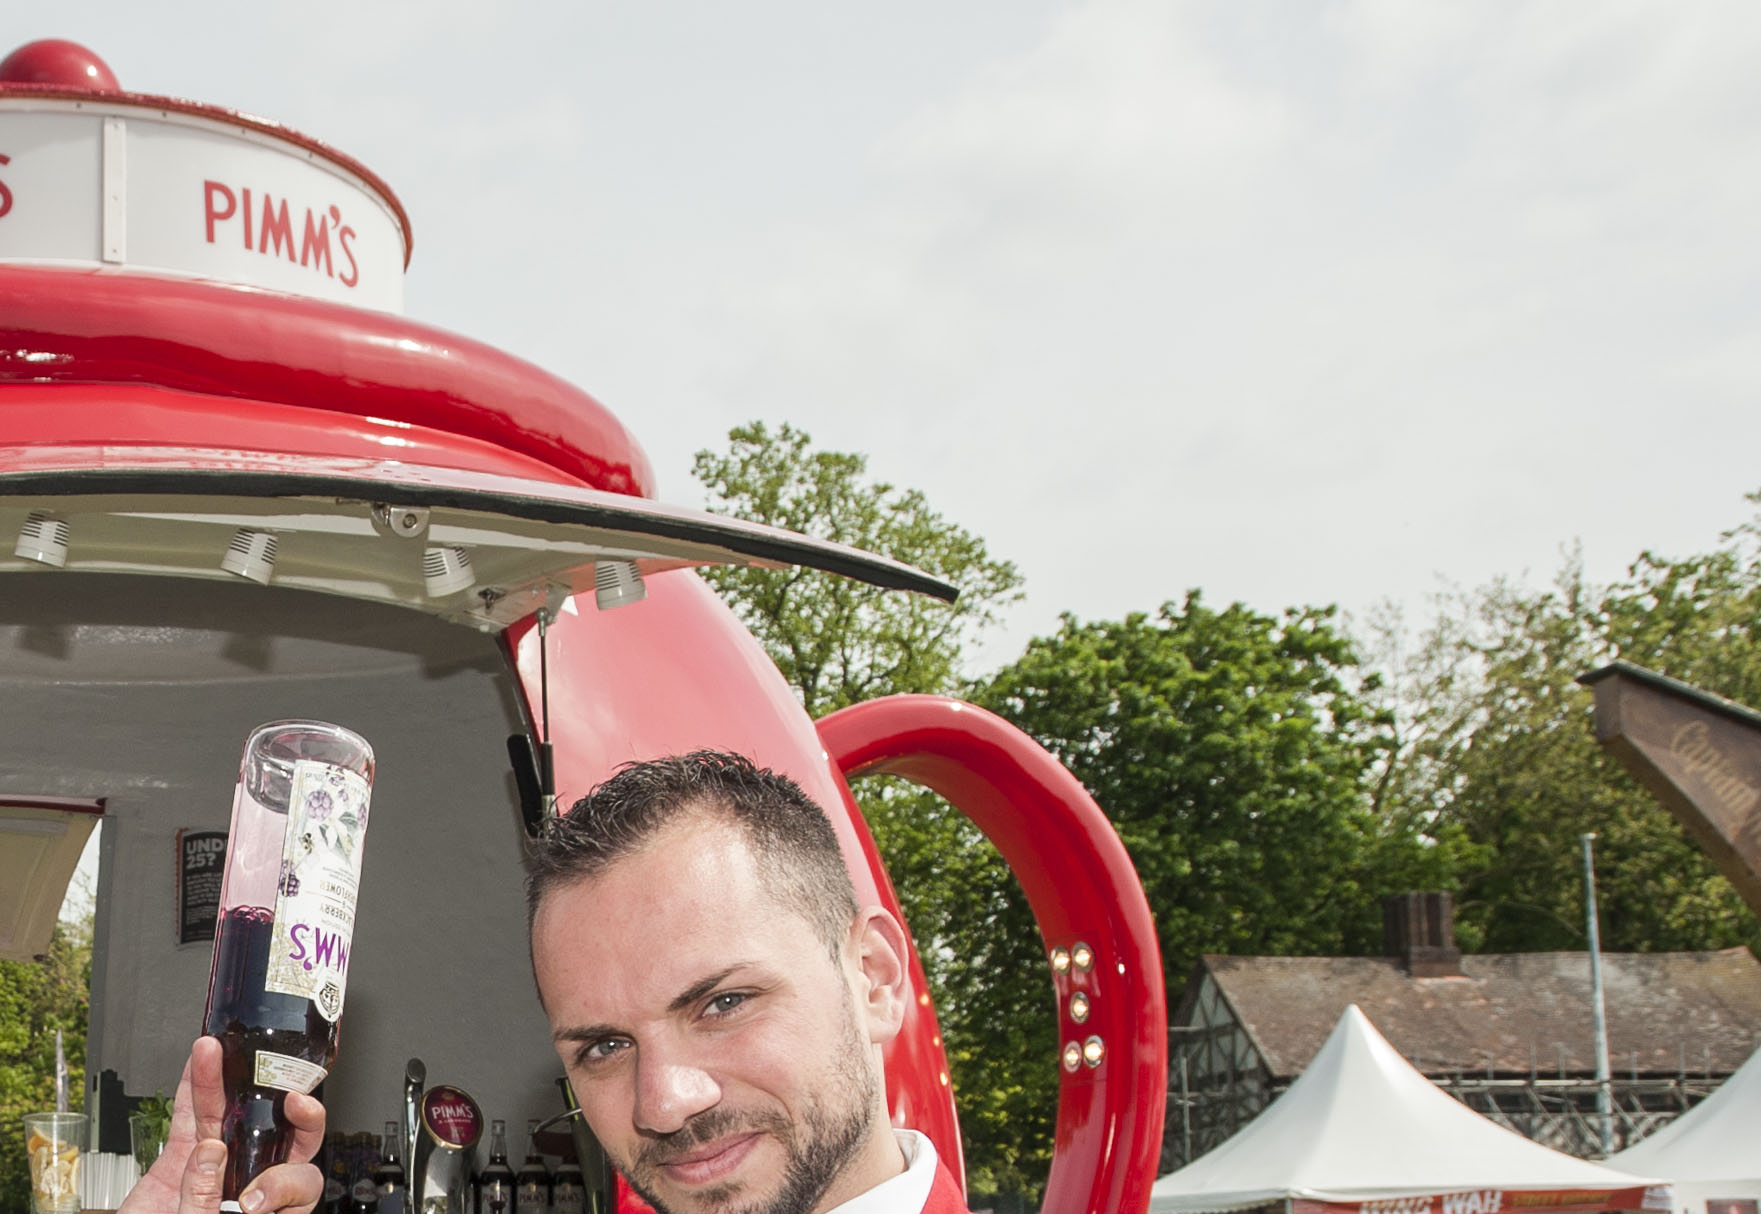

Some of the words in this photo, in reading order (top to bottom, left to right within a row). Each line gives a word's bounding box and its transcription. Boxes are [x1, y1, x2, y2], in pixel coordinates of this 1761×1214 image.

[204, 179, 359, 288] PIMM'S
[185, 838, 227, 855] UND
[185, 852, 217, 870] 25?
[289, 923, 351, 976] MM'S
[431, 1103, 474, 1120] PIMM'S
